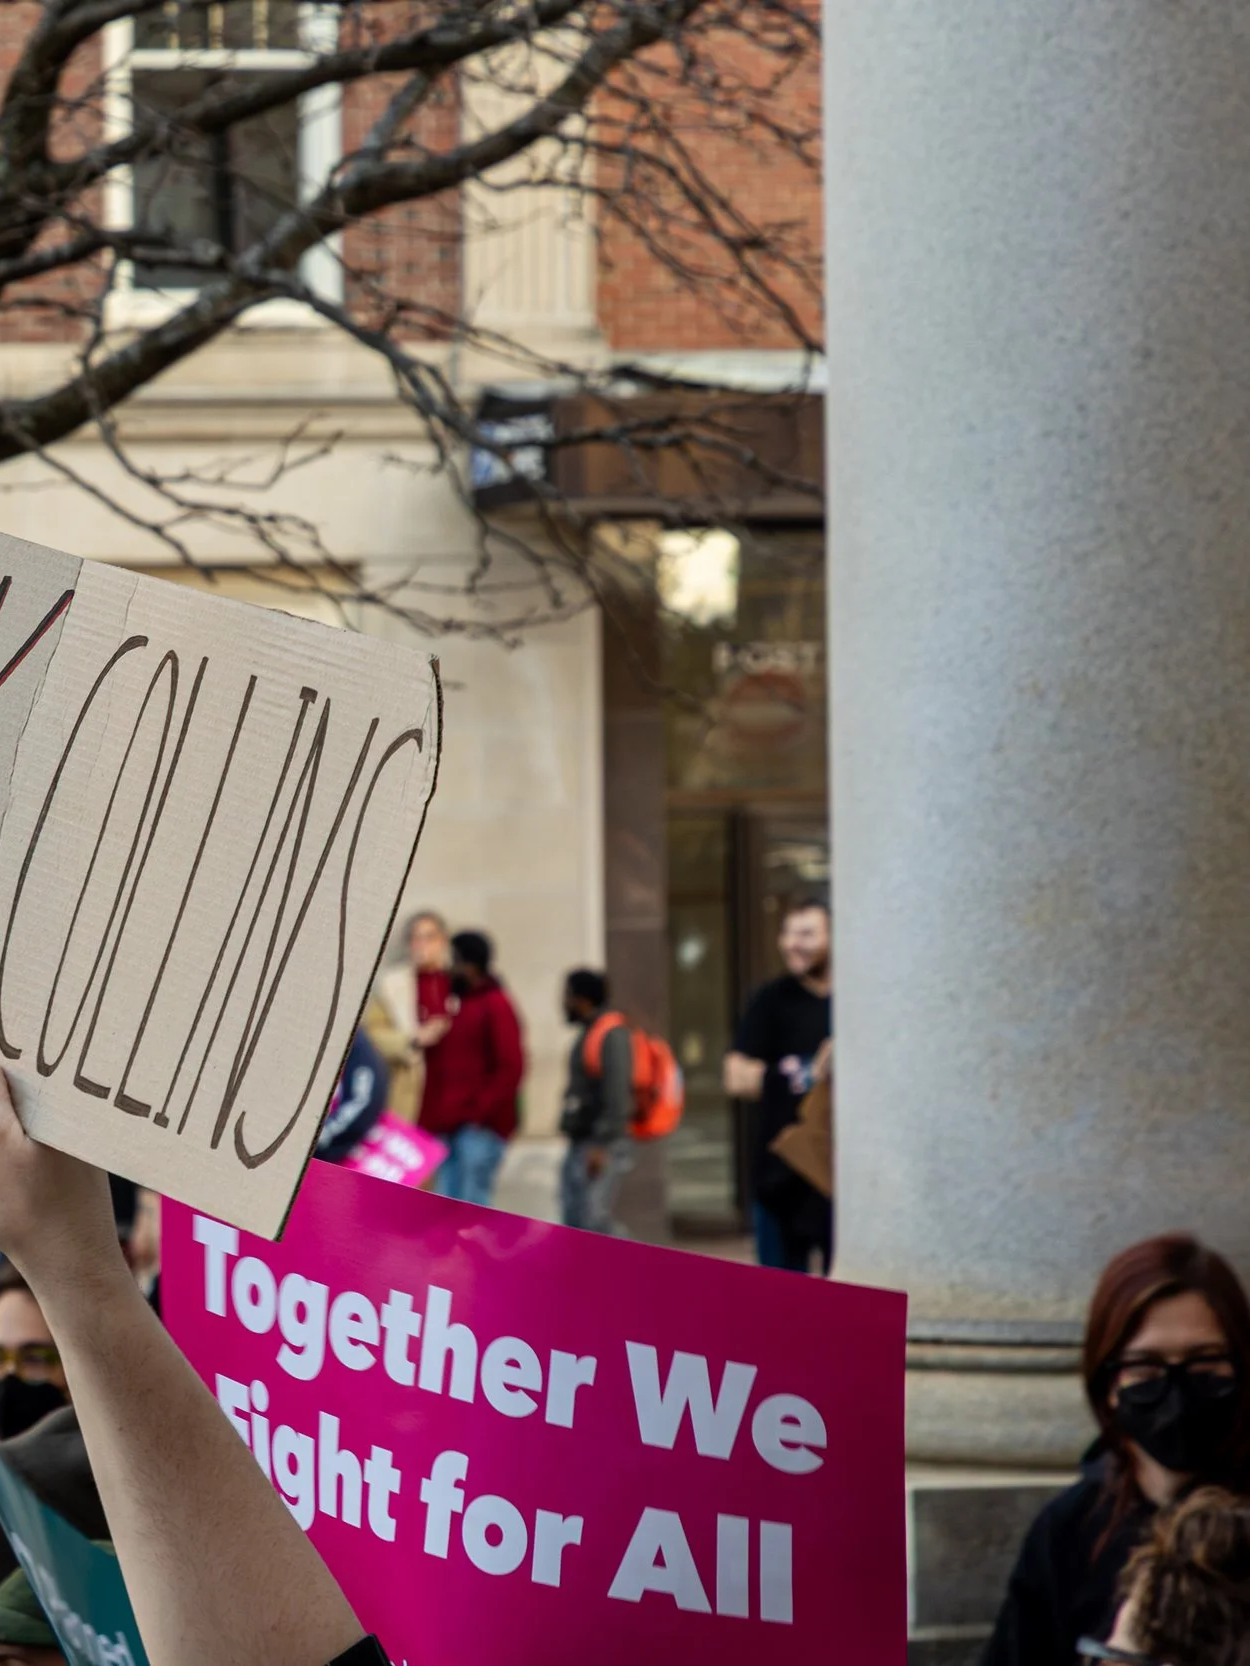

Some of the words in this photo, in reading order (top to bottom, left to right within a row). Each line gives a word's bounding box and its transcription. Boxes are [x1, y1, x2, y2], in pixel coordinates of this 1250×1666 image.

[192, 1213, 597, 1429] Together
[625, 1339, 828, 1475] We
[214, 1372, 402, 1543] Fight
[420, 1450, 585, 1588] for
[606, 1506, 794, 1625] All
